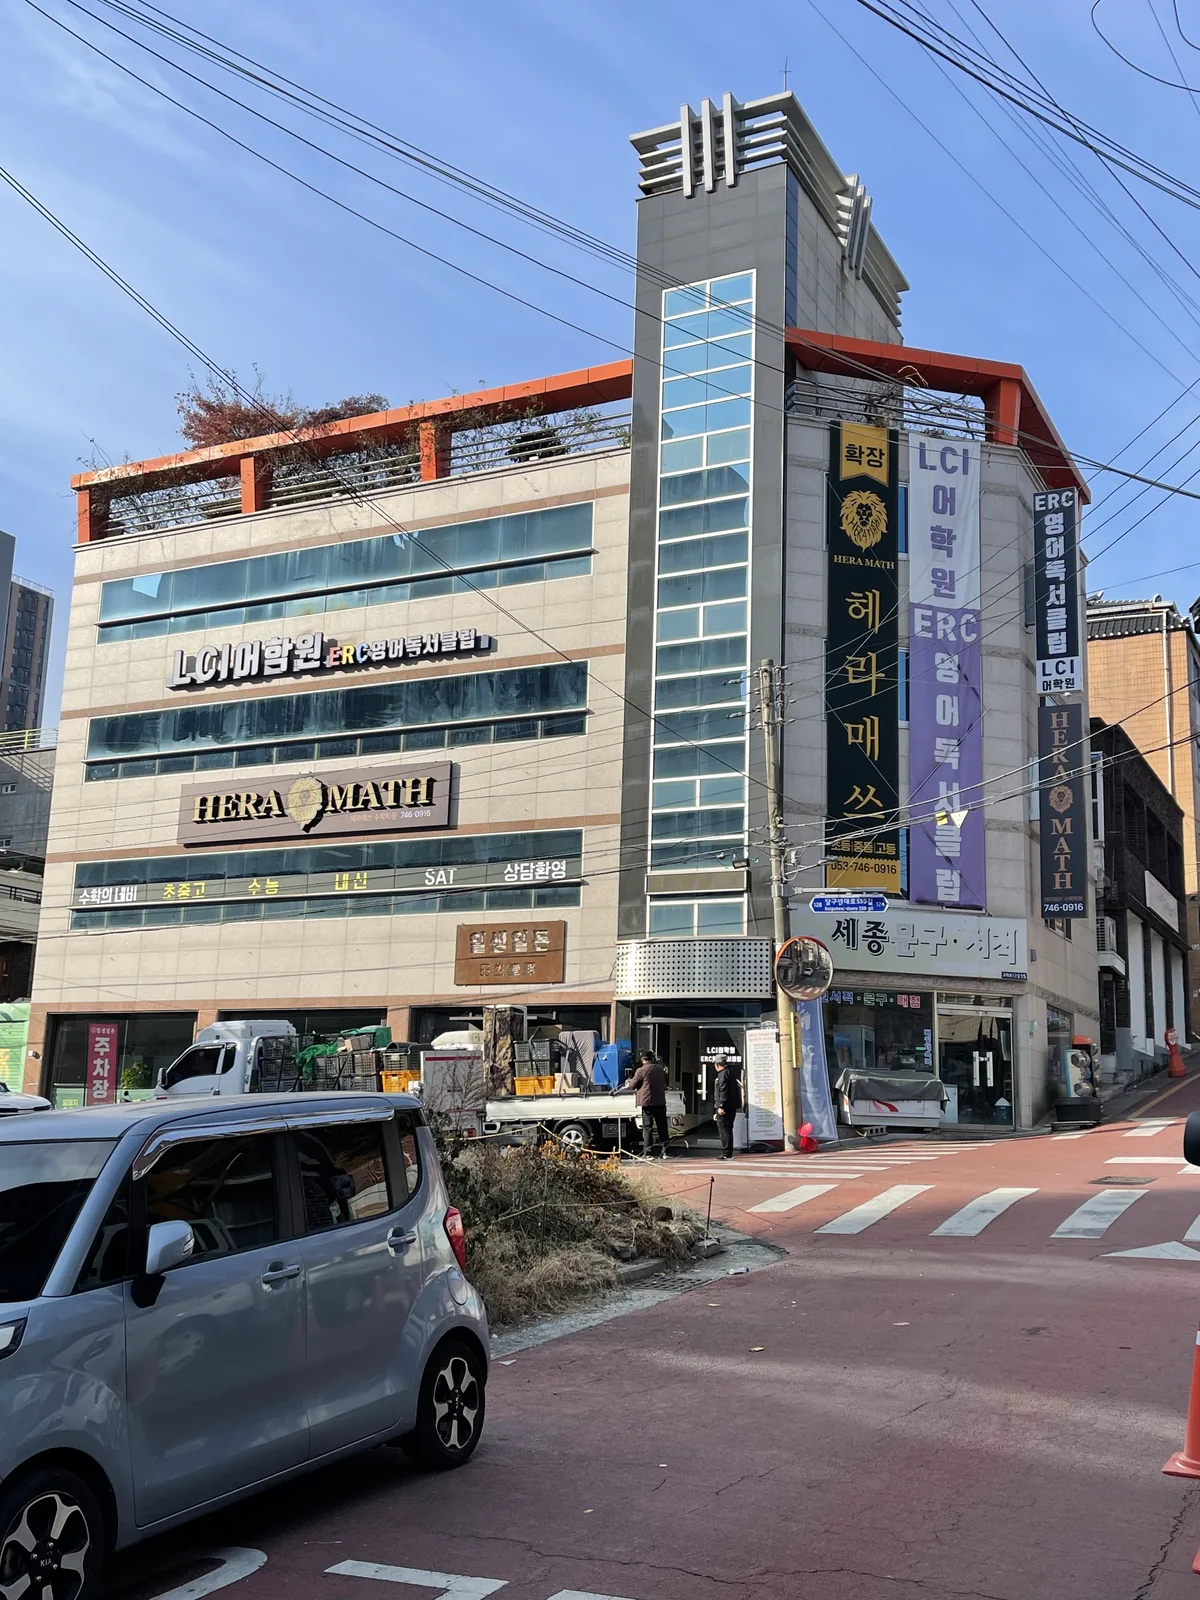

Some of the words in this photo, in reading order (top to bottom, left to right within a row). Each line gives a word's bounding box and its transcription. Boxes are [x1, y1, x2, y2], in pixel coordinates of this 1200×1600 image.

[845, 443, 885, 469] 확장
[919, 442, 969, 476] LCI
[1035, 490, 1074, 511] ERC
[930, 484, 957, 599] 어학원
[833, 554, 863, 566] HERA
[864, 558, 895, 570] MATH
[1044, 512, 1068, 655] 영어독서클럽
[914, 608, 978, 643] ERC
[172, 631, 324, 686] LCI어학원
[329, 627, 477, 667] ERC영어독서클럽
[1042, 659, 1075, 677] LCI
[1042, 677, 1076, 692] 어학원
[1050, 711, 1071, 779] HERA
[934, 651, 962, 902] 영어독서클럽
[191, 789, 280, 823] HERA
[327, 776, 431, 812] MATH
[1051, 818, 1074, 889] MATH
[425, 868, 457, 886] SAT
[504, 860, 567, 883] 상담환영
[831, 861, 897, 874] 053-746-0916
[163, 882, 206, 900] 초중고
[248, 878, 281, 896] 수능
[334, 872, 369, 891] 내신
[79, 888, 113, 905] 수학의
[1043, 902, 1084, 912] 746-0916
[92, 1036, 111, 1099] 주차장
[40, 1558, 52, 1567] KIA
